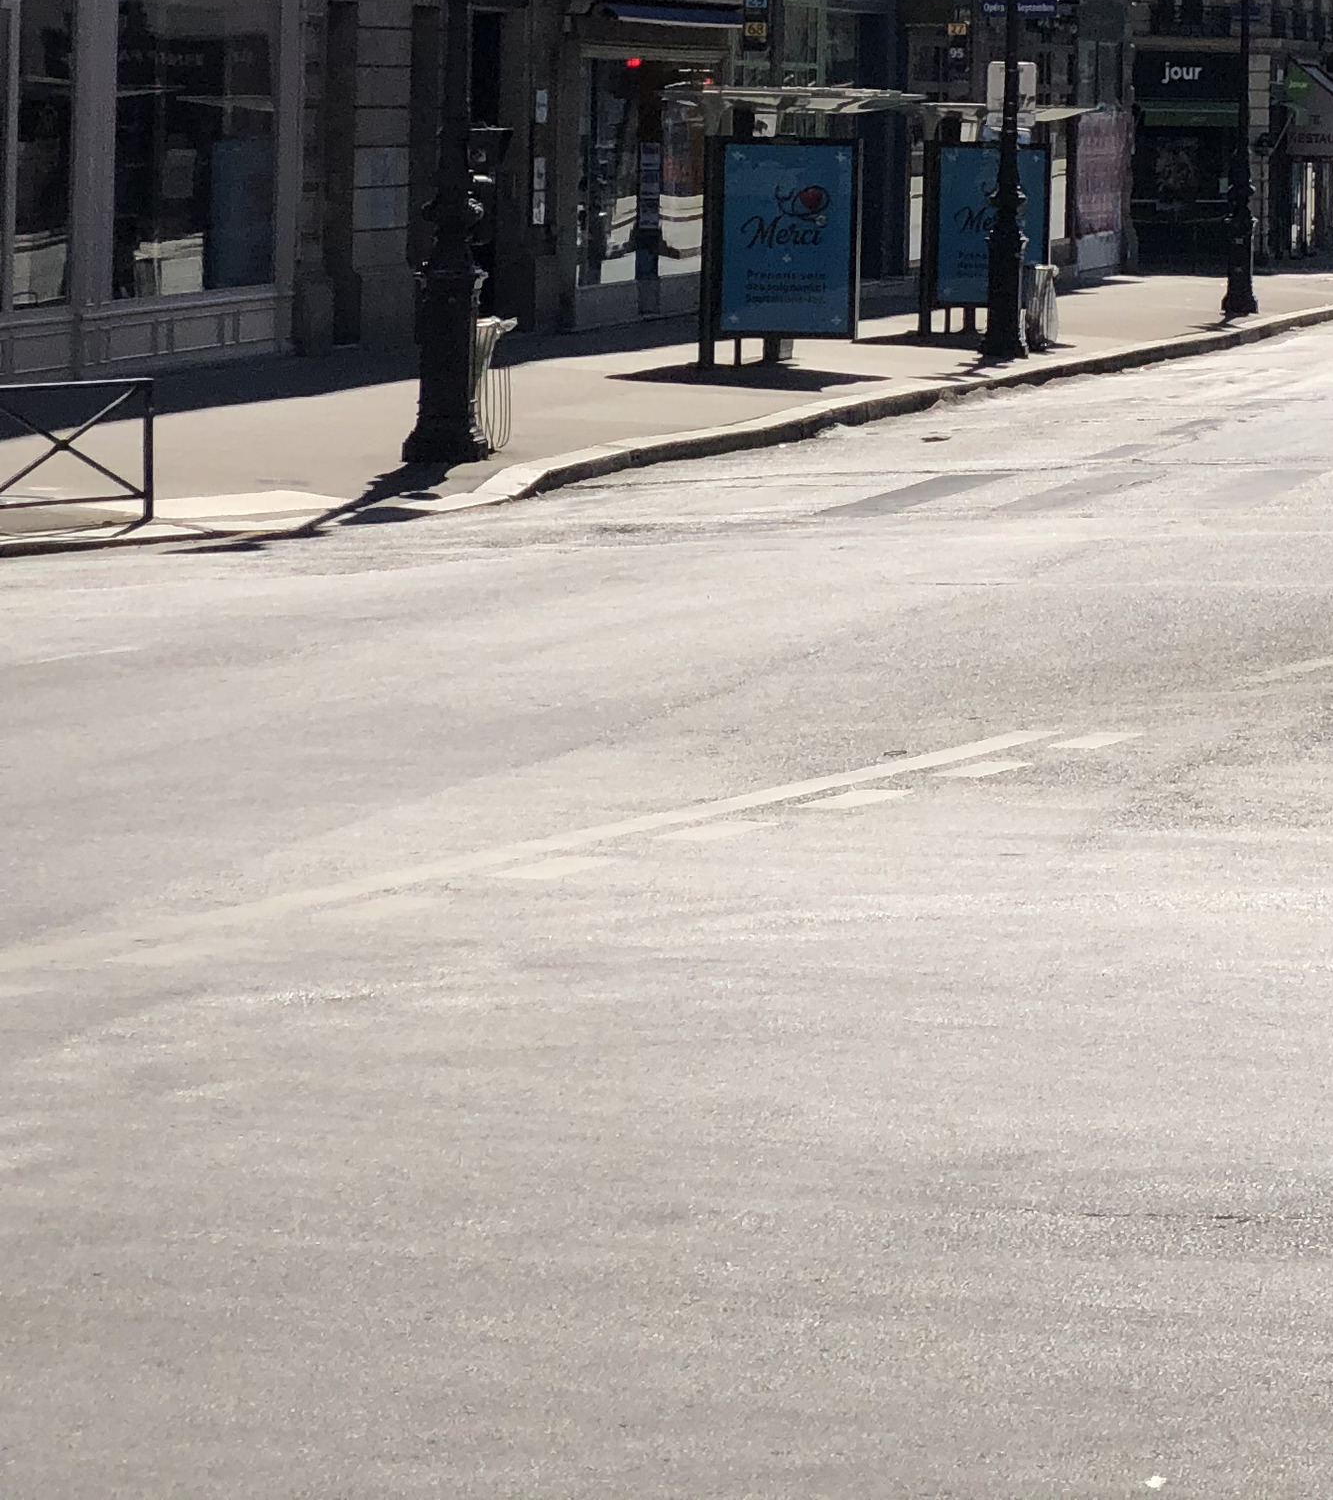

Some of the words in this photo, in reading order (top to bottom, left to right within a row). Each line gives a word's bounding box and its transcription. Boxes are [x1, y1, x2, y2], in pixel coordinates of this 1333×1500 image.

[747, 23, 765, 36] 68
[949, 24, 965, 34] 27
[950, 47, 965, 59] 95
[1161, 61, 1203, 84] jour
[740, 215, 821, 249] Merci
